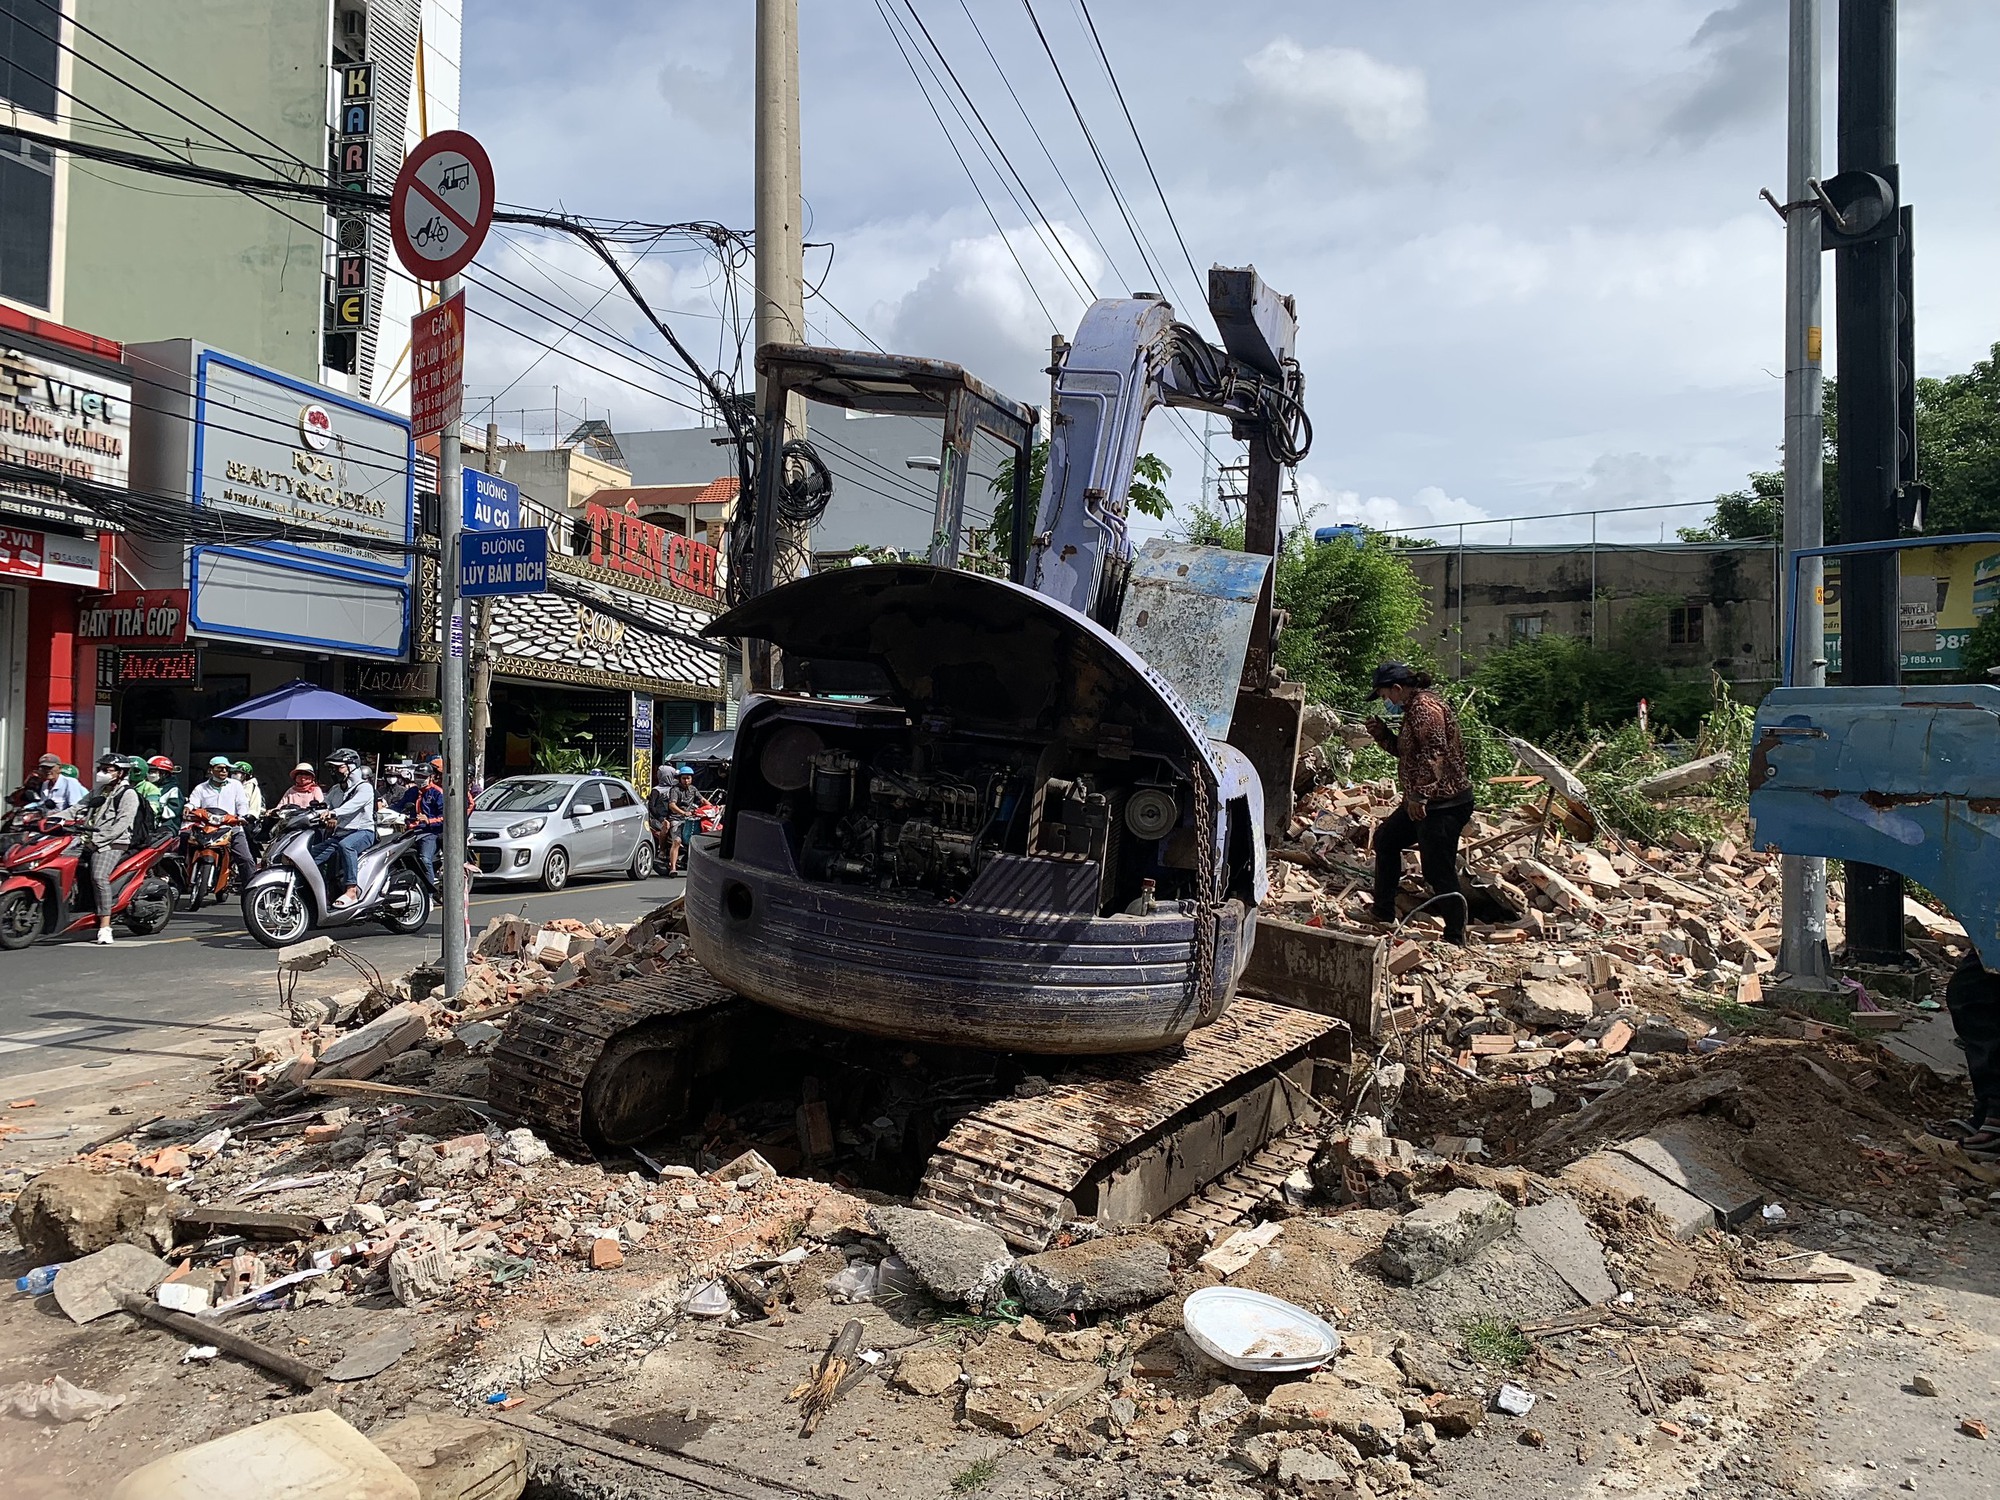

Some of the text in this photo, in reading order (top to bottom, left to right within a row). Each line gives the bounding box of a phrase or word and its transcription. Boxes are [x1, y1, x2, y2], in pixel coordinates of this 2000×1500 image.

[65, 425, 123, 456] CAMERA
[226, 460, 295, 494] BEAUTY
[477, 478, 507, 501] ĐƯỜNG
[475, 497, 509, 529] ÂU CƠ
[481, 537, 525, 555] ĐƯỜNG
[462, 556, 543, 585] LŨY BÁN BÍCH
[669, 534, 718, 599] CHI
[146, 599, 180, 637] GÓP
[1910, 655, 1942, 664] f88.vn
[359, 667, 430, 692] KARAOKE
[636, 719, 650, 729] 900
